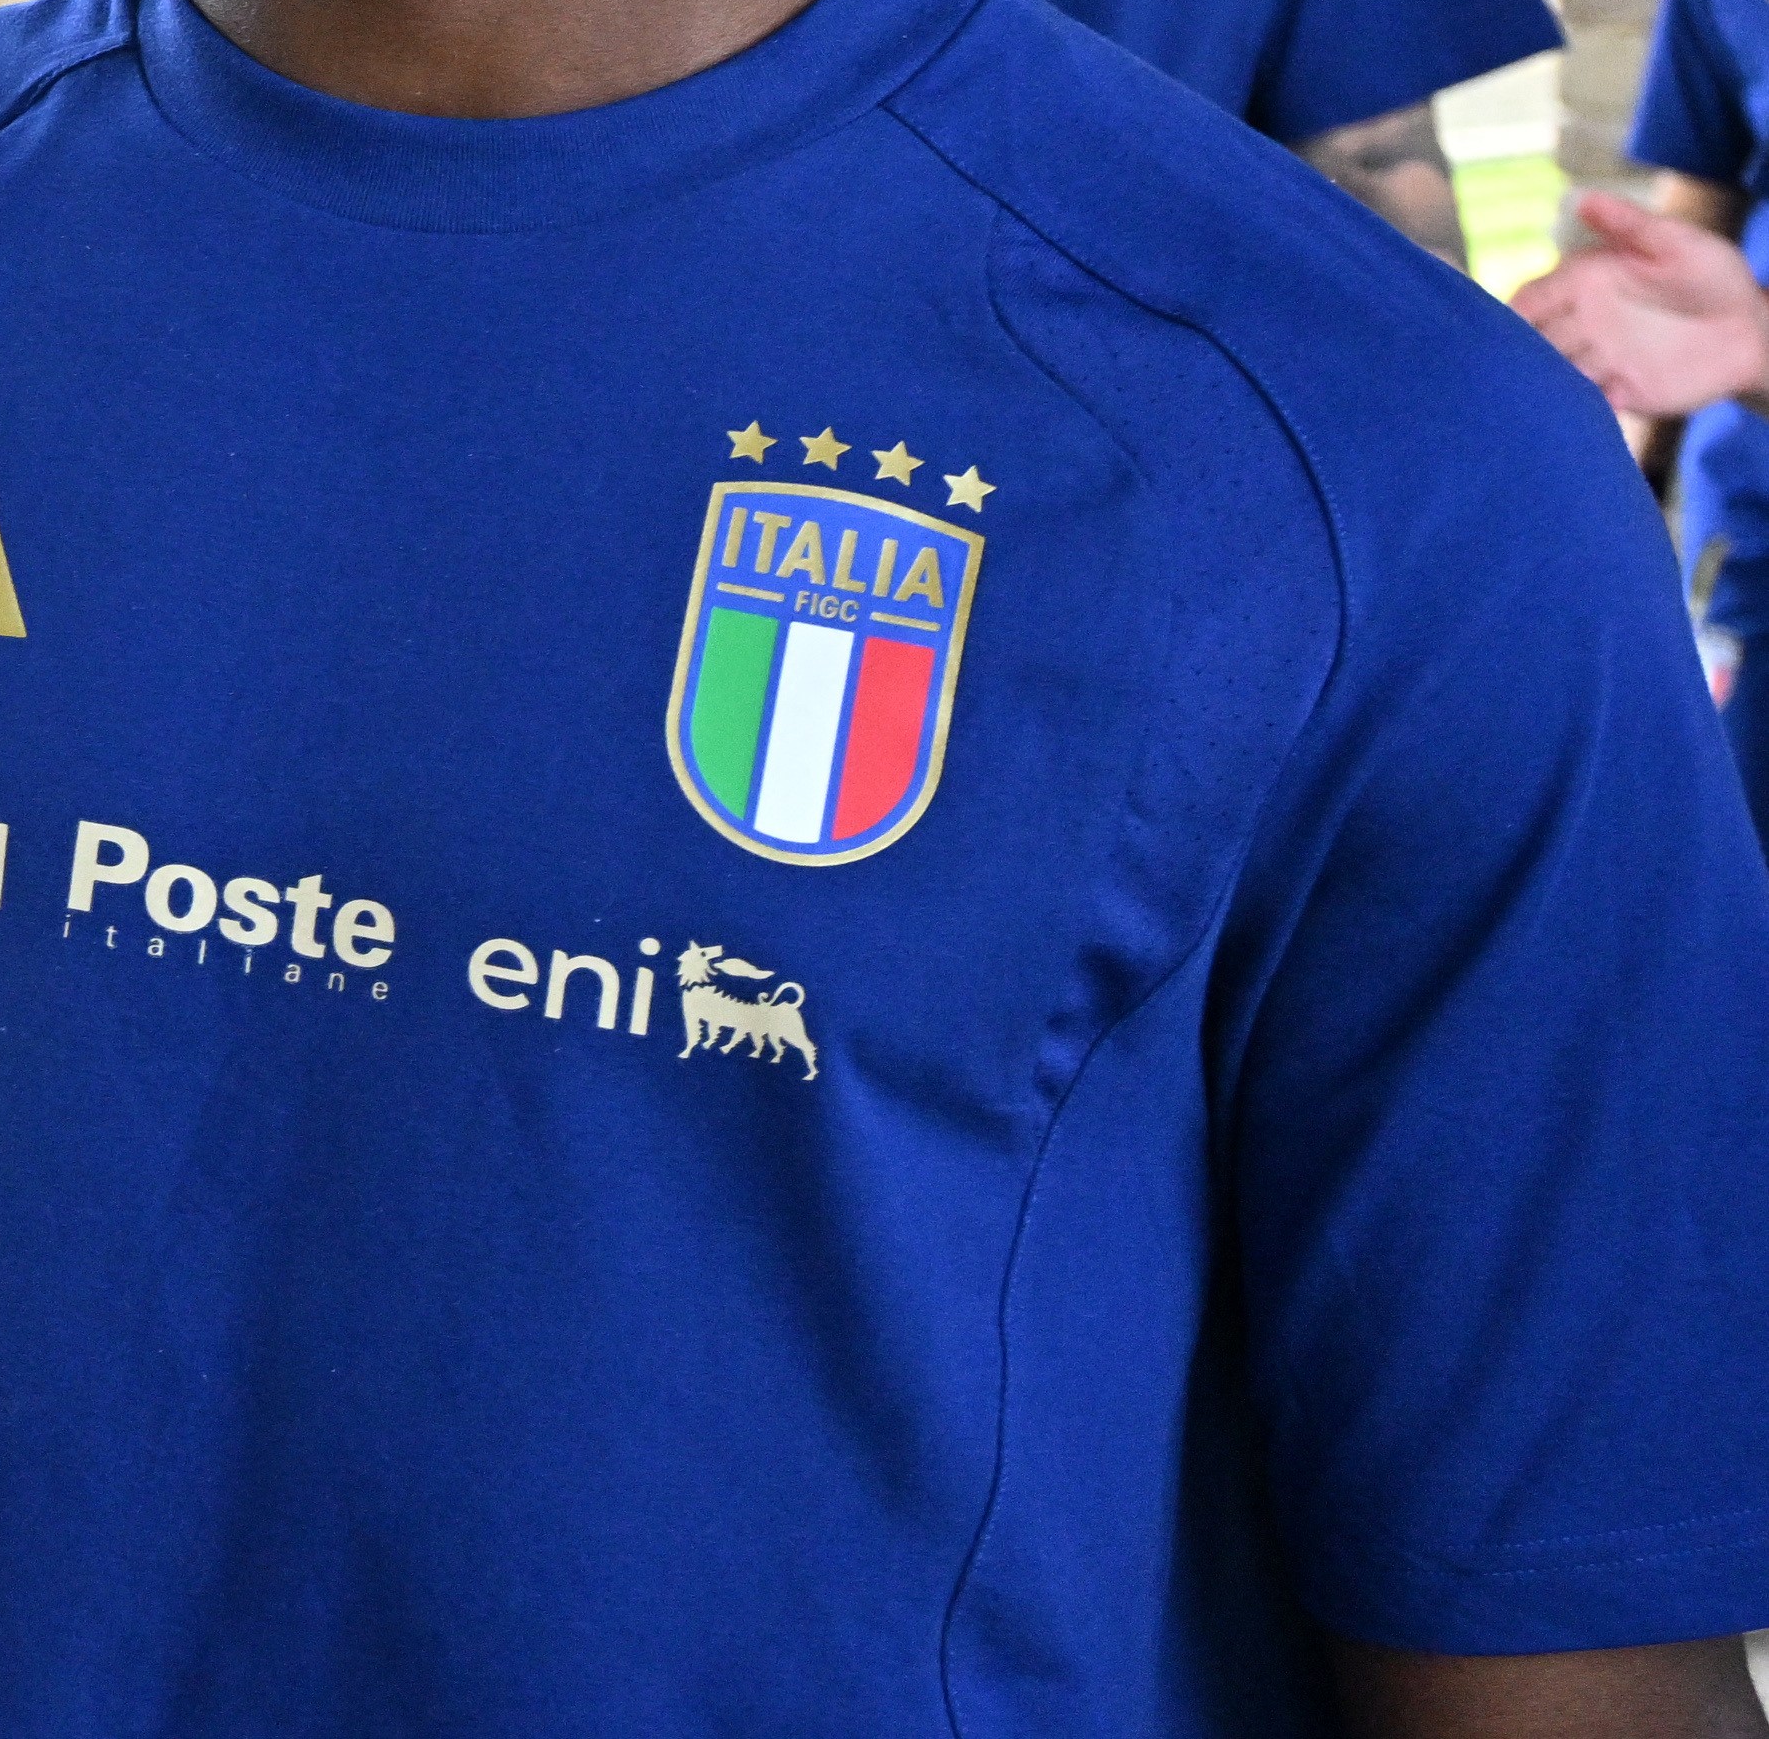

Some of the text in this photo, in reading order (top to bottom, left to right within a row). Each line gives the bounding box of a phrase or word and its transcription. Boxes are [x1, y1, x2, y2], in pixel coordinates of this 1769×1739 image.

[721, 506, 945, 609] ITALIA
[793, 590, 860, 623] FIGC
[62, 913, 390, 1001] italiane
[66, 820, 396, 968] Poste
[468, 937, 661, 1036] eni
